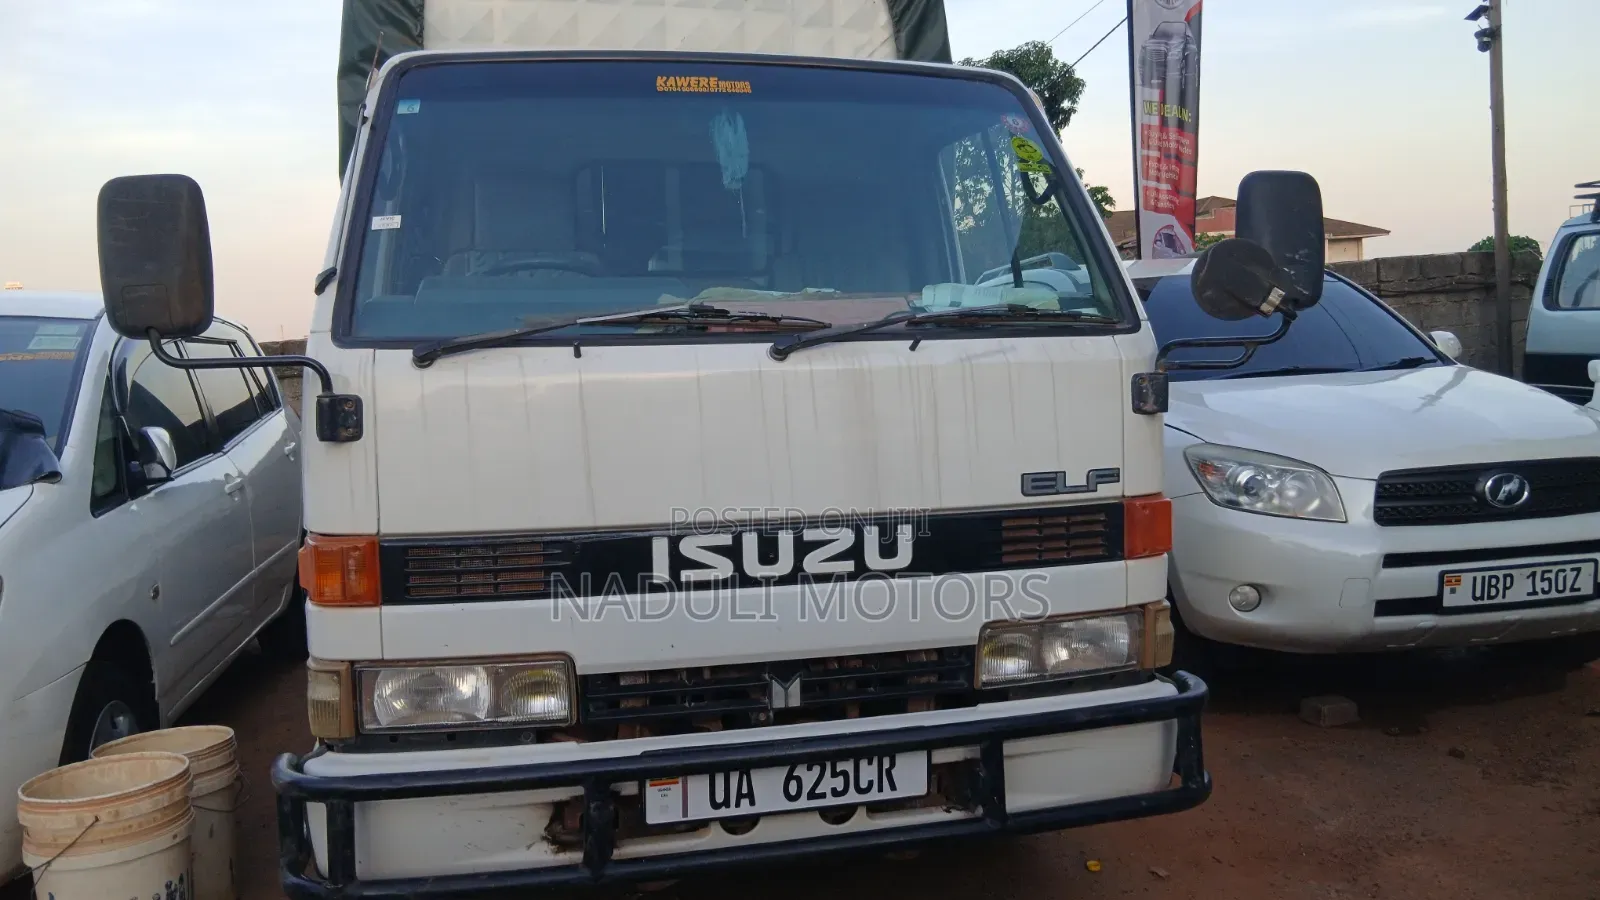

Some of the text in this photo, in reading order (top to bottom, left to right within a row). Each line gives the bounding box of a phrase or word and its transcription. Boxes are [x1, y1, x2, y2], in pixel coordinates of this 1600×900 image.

[656, 76, 750, 89] KAWERE MOTORS
[1143, 100, 1158, 116] WE
[1021, 467, 1120, 496] ELF
[651, 522, 913, 585] ISUZU
[1471, 566, 1582, 602] UBP 150Z
[708, 753, 898, 811] UA 625CR
